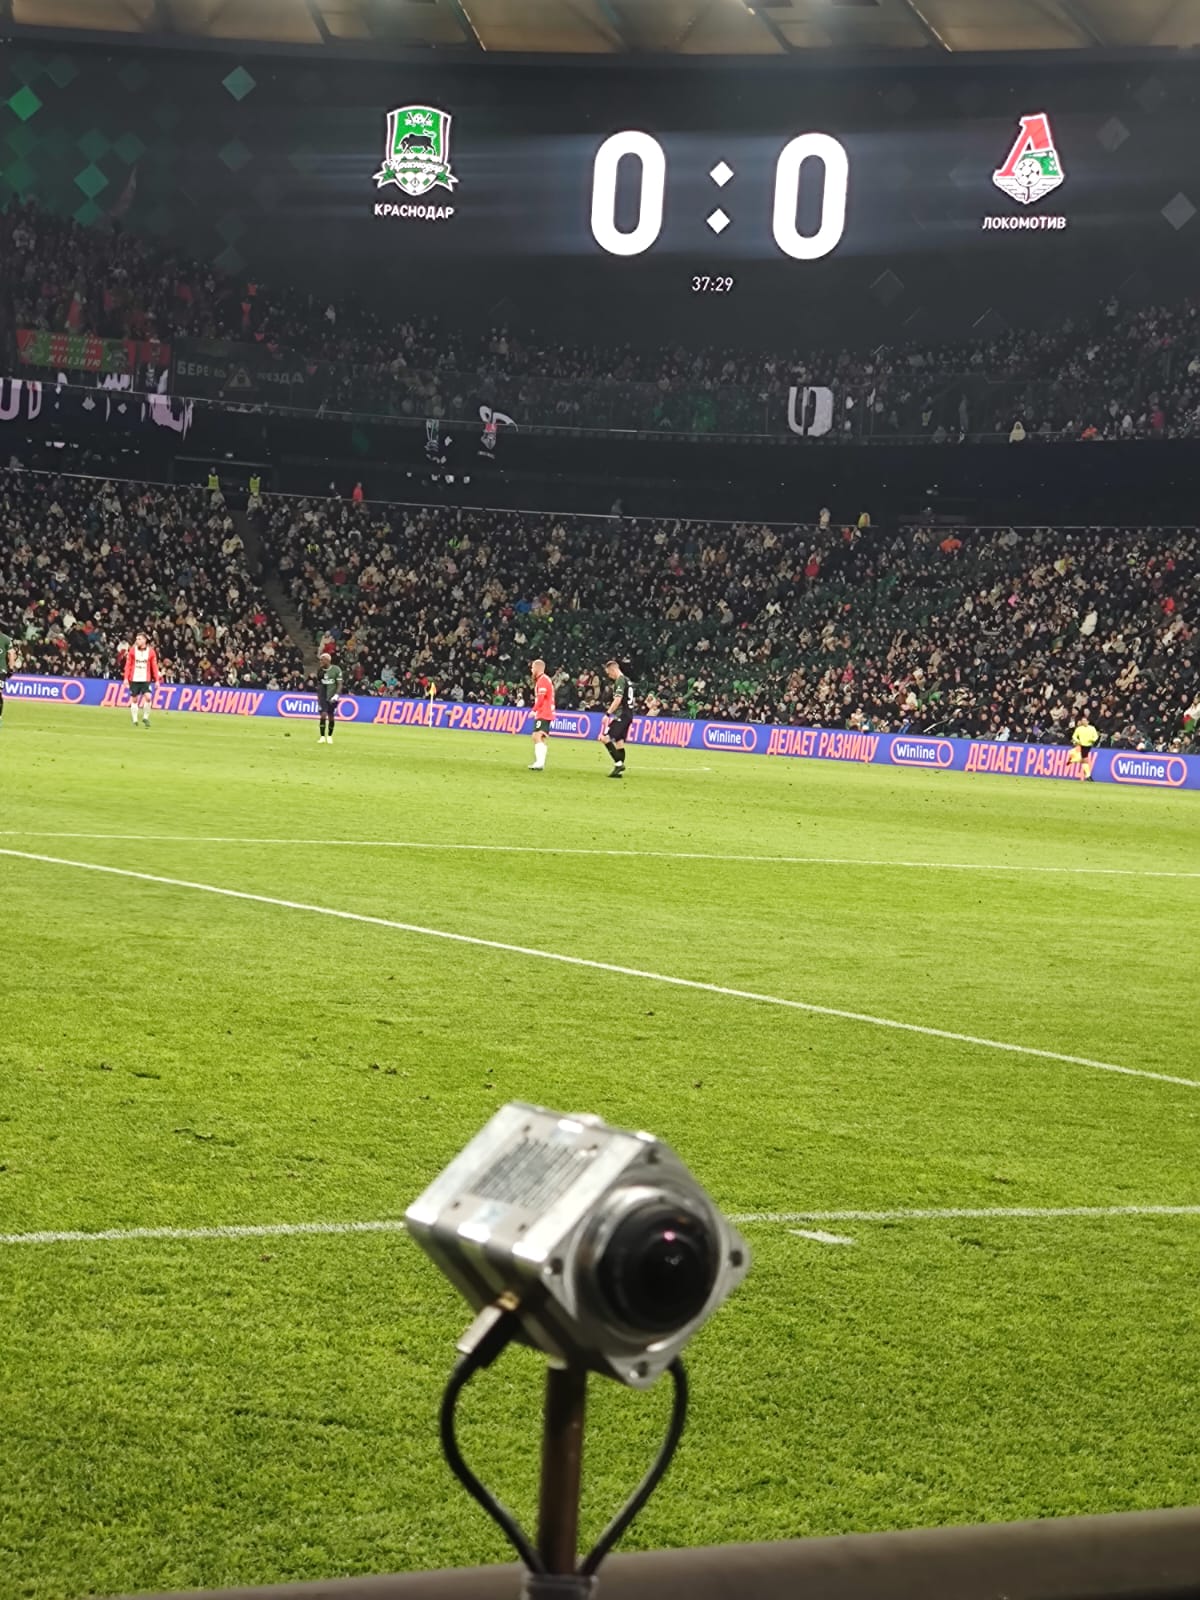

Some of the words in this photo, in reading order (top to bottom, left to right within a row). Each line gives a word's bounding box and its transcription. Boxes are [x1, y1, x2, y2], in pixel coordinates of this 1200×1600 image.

[374, 203, 454, 219] КРАСНОДАР
[982, 216, 1066, 229] ЛОКОМОТИВ
[692, 276, 734, 291] 37:29
[5, 681, 59, 697] Winline
[101, 682, 177, 710] ДЕЕТ
[177, 686, 264, 716] РАЗНИЦУ
[373, 700, 447, 726] ДЕЛАЕТ
[448, 704, 529, 735] РАЗНИЦУ
[641, 719, 694, 748] РАЗНИЦУ
[708, 729, 741, 744] Winline
[767, 728, 817, 755] ДЕЛАЕТ
[818, 732, 879, 763] РАЗНИЦУ
[896, 743, 935, 760] Winline
[964, 743, 1024, 772] ДЕЛАЕТ
[1118, 759, 1164, 778] Winline
